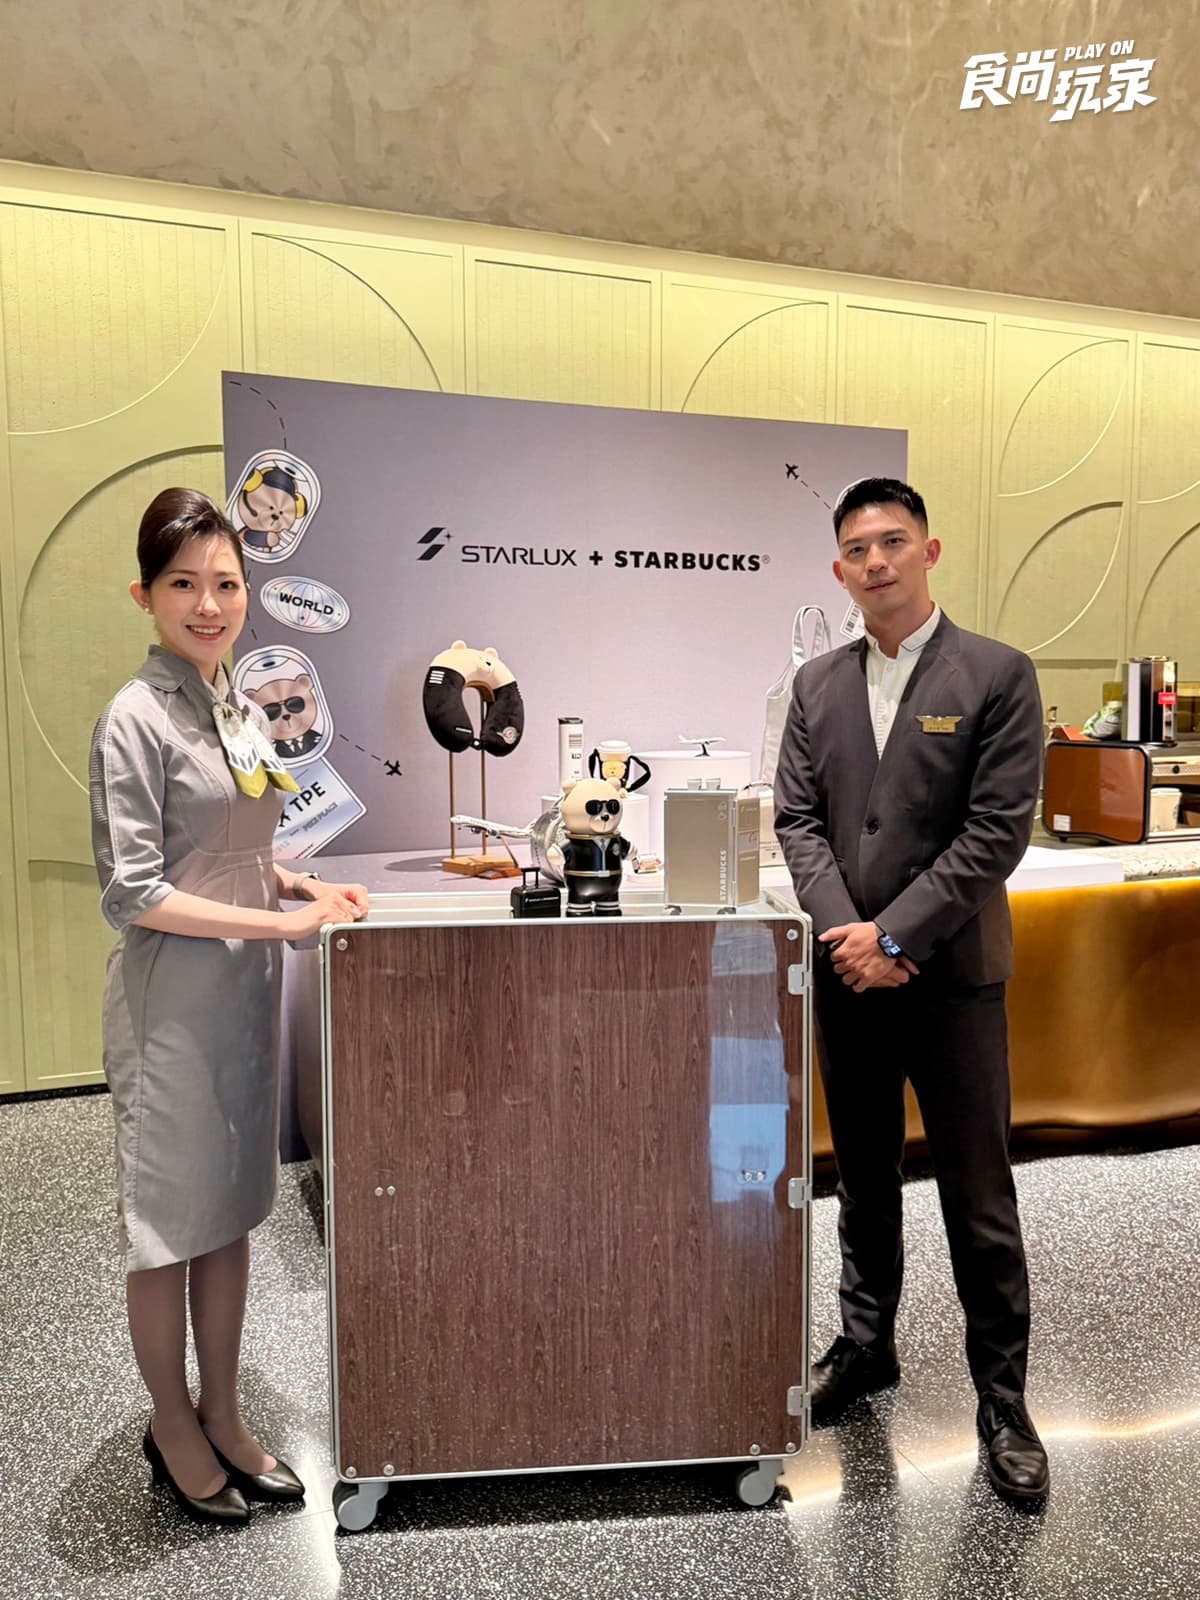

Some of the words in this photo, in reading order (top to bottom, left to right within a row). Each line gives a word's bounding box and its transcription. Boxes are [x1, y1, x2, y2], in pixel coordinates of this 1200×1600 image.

[461, 545, 578, 567] STARLUX
[279, 592, 335, 616] WORLD
[289, 781, 326, 812] TPE
[719, 849, 727, 902] STARBUCKS
